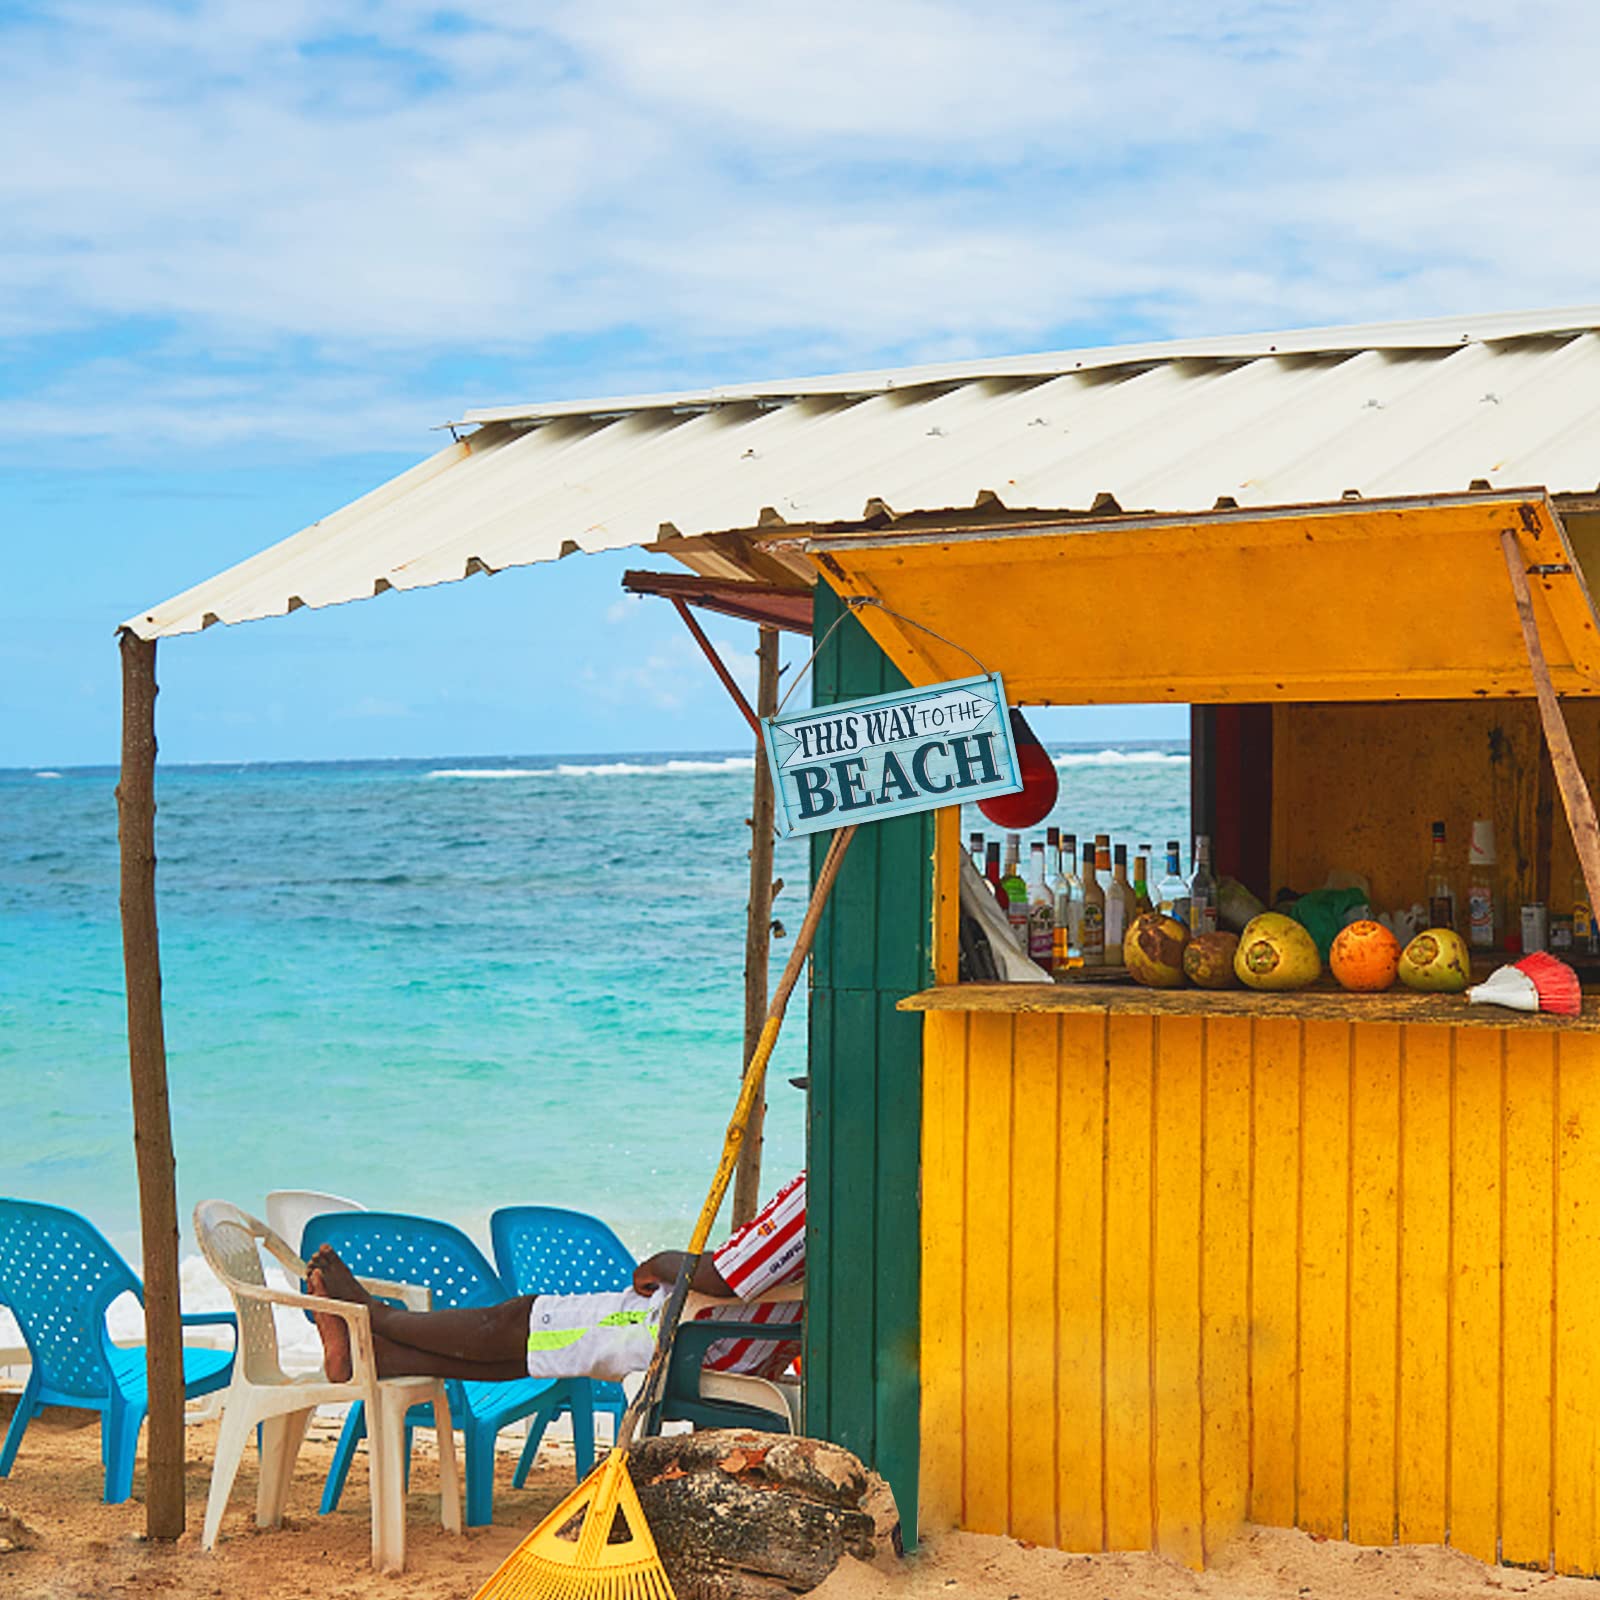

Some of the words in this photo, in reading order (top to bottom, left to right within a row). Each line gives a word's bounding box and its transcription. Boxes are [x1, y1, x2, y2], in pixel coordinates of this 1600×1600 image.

[795, 716, 859, 758] THIS
[862, 705, 919, 745] WAY
[790, 731, 1005, 820] BEACH
